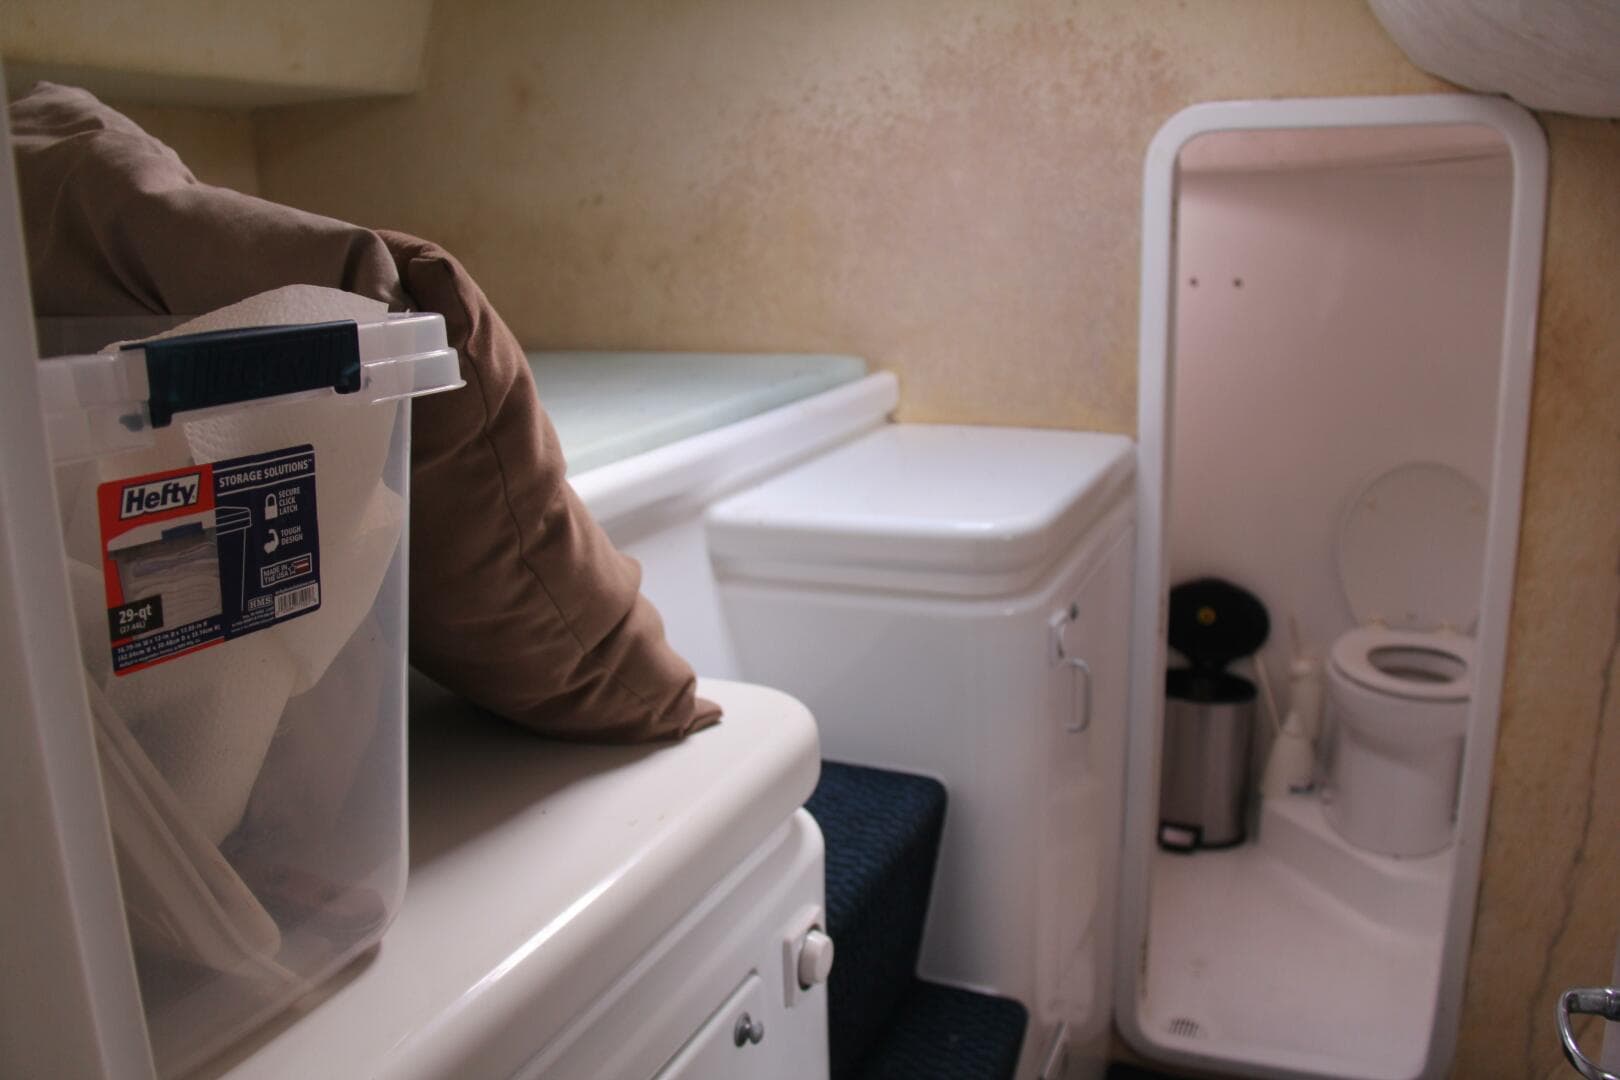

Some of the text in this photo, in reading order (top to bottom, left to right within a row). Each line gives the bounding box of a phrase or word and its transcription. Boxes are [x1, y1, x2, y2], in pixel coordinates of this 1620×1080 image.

[219, 470, 262, 488] STORAGE
[125, 483, 195, 513] Hefty
[279, 487, 300, 498] SECURE
[279, 496, 296, 507] CLICK
[280, 504, 298, 515] LATCH
[281, 525, 301, 537] TOUGH
[281, 533, 304, 545] DESIGN
[264, 566, 280, 576] MADE
[265, 570, 289, 584] THE USA
[119, 603, 152, 624] 29-qt
